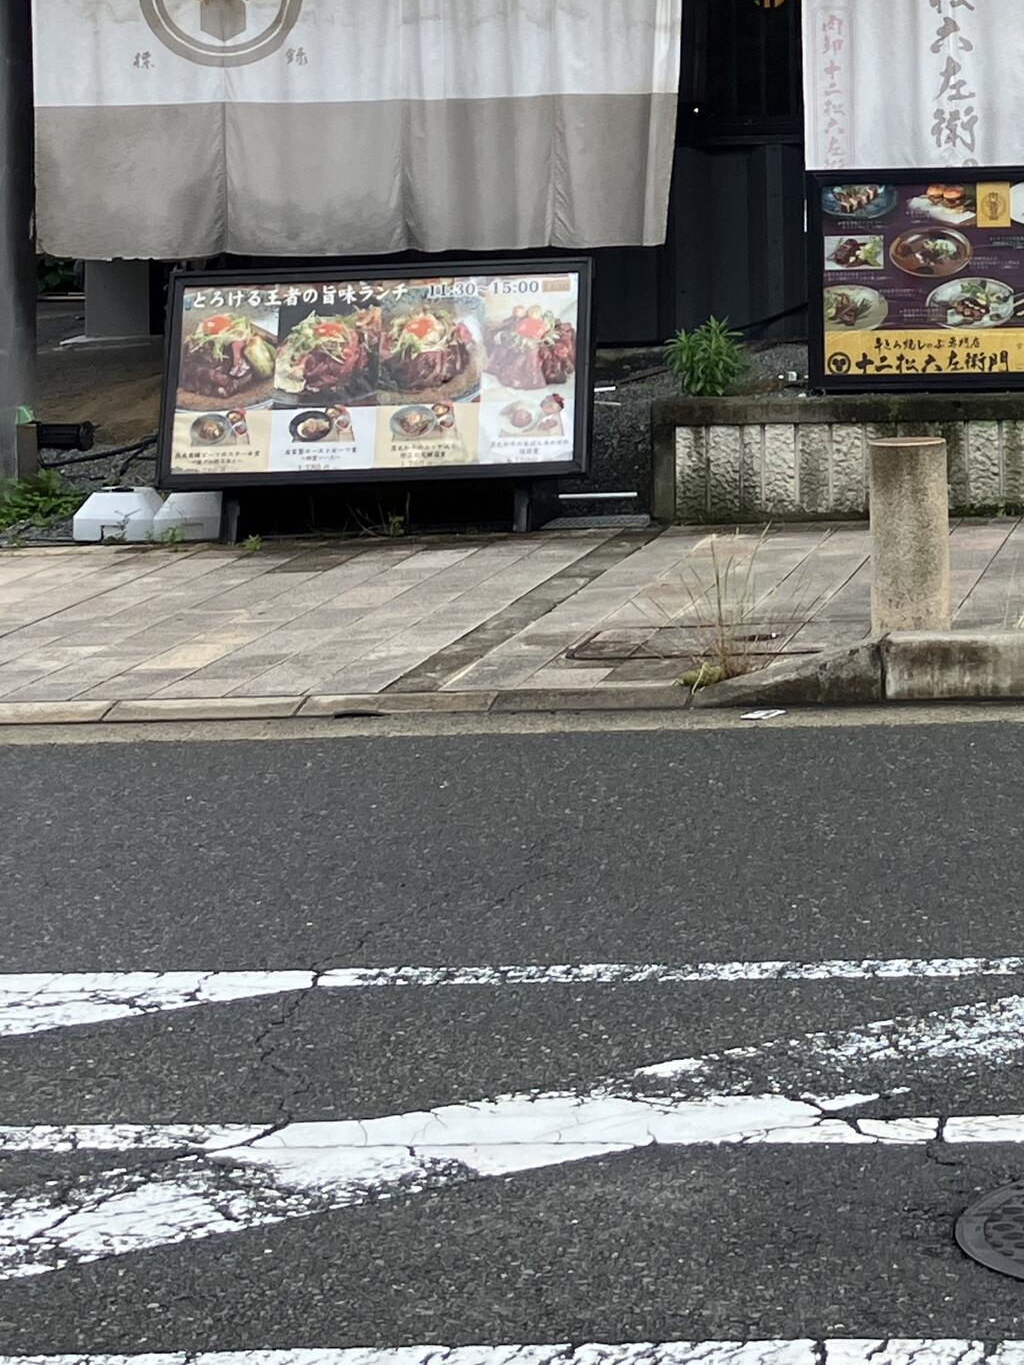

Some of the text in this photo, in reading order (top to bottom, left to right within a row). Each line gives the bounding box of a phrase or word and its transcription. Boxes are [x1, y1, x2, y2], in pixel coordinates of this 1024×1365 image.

[193, 283, 409, 309] とろける王者の旨味ランチ
[855, 350, 1009, 374] 十二松六左衛門
